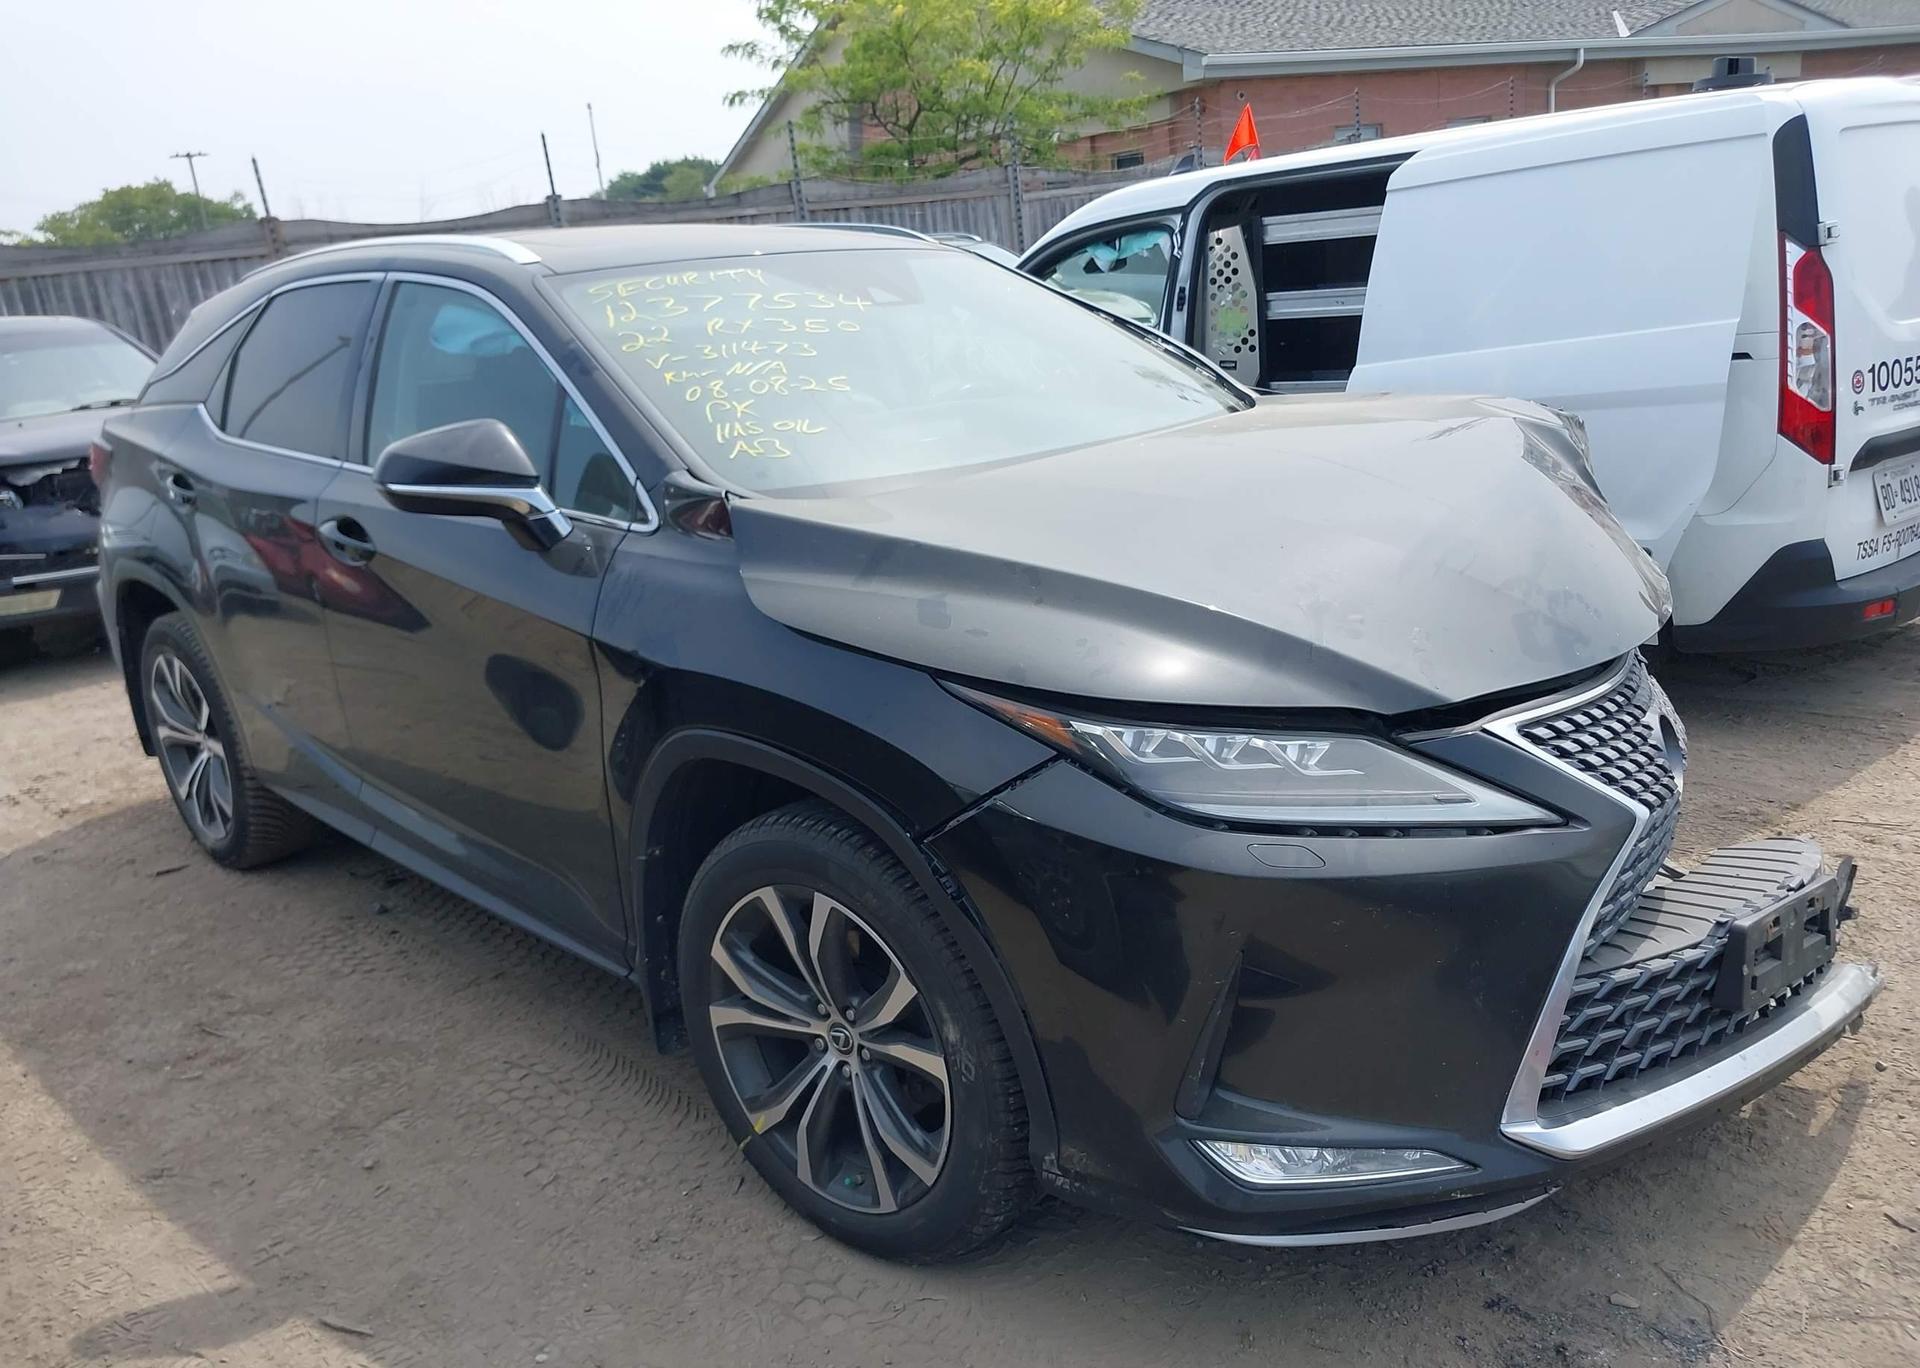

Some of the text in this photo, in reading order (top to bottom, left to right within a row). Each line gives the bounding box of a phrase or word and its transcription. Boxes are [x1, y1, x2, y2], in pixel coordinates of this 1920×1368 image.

[588, 268, 768, 304] SECURITY
[606, 293, 873, 329] 12377534
[618, 326, 672, 352] 22
[763, 317, 861, 333] 350
[695, 340, 818, 360] 311473
[726, 360, 788, 376] N/A
[686, 375, 851, 402] 08-08-25
[717, 419, 828, 443] HAS OIL
[1856, 537, 1880, 561] TSSA
